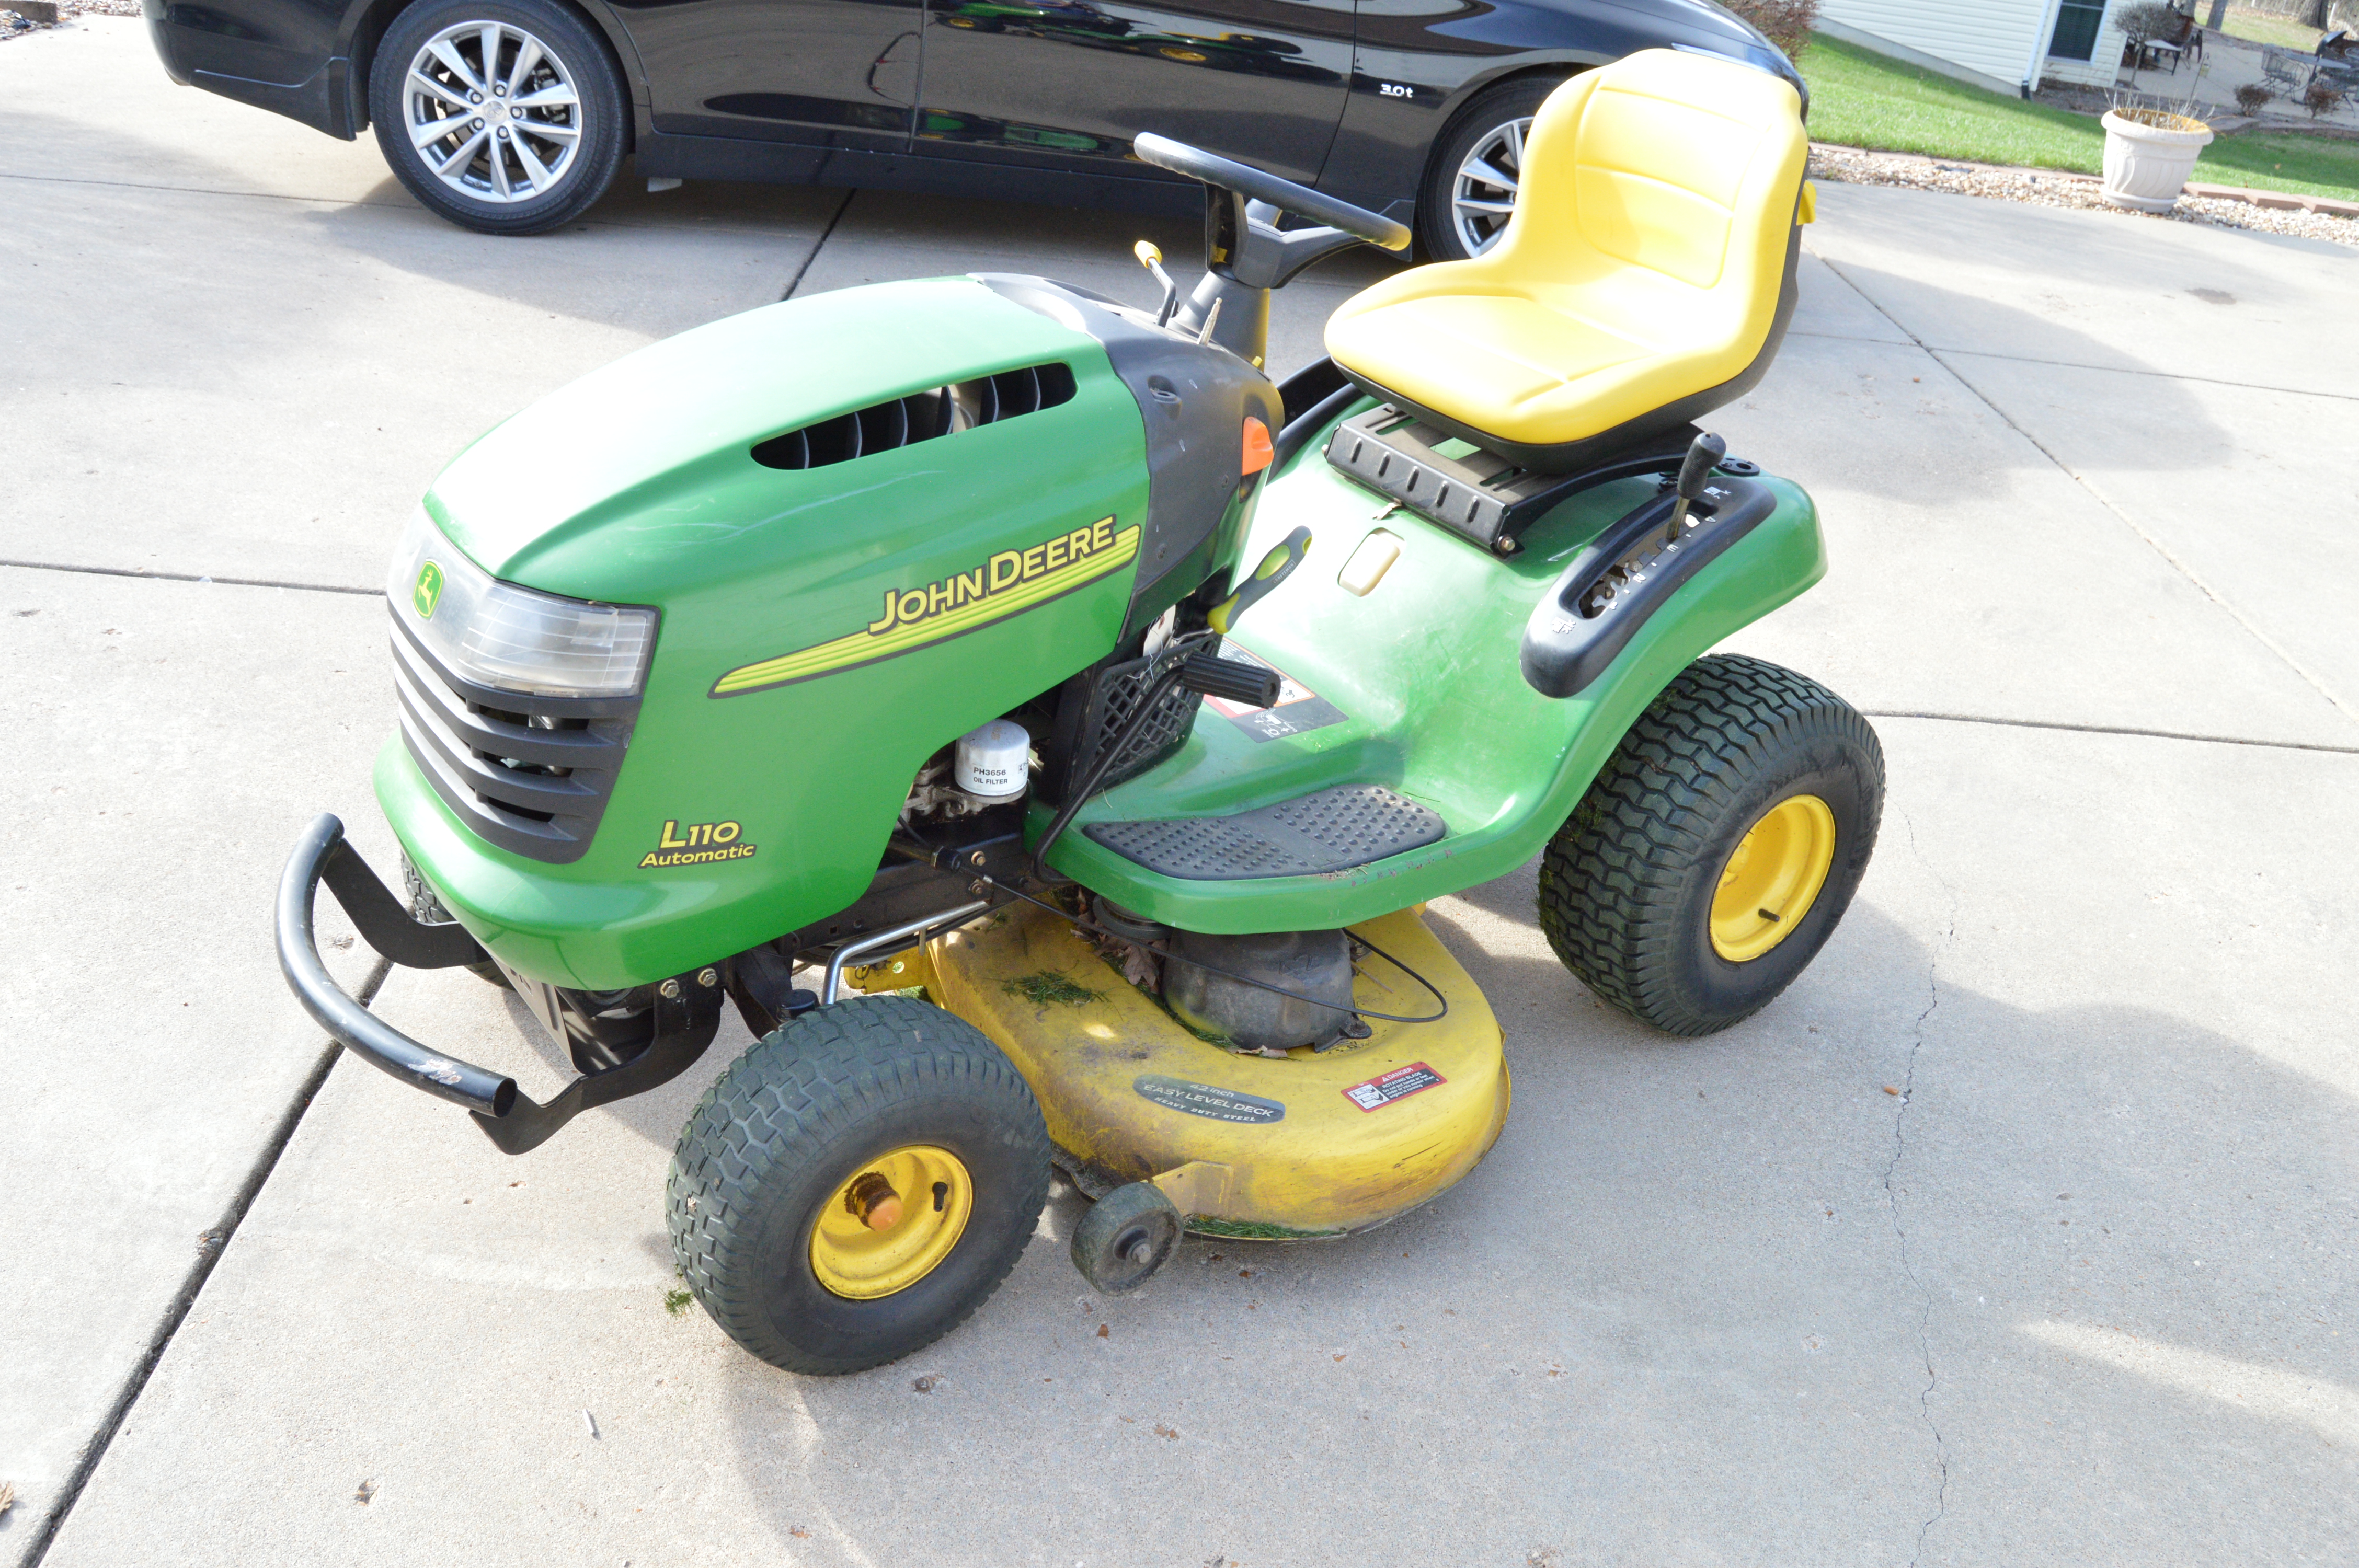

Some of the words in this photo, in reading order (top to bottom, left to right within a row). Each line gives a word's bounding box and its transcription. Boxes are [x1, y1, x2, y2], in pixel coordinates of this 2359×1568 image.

[869, 568, 983, 635] JOHN
[989, 515, 1114, 593] DEERE
[973, 767, 1006, 776] PH3656
[660, 821, 739, 848] L110
[640, 844, 754, 867] Automatic
[1382, 1077, 1406, 1088] ROTATING
[1387, 1067, 1414, 1079] DANGER
[1143, 1085, 1185, 1096] EASY
[1185, 1093, 1230, 1108] LEVEL
[1233, 1103, 1275, 1117] DECK
[1209, 1087, 1235, 1098] inch
[1154, 1097, 1187, 1109] HEAVY
[1190, 1108, 1218, 1116] DUTY
